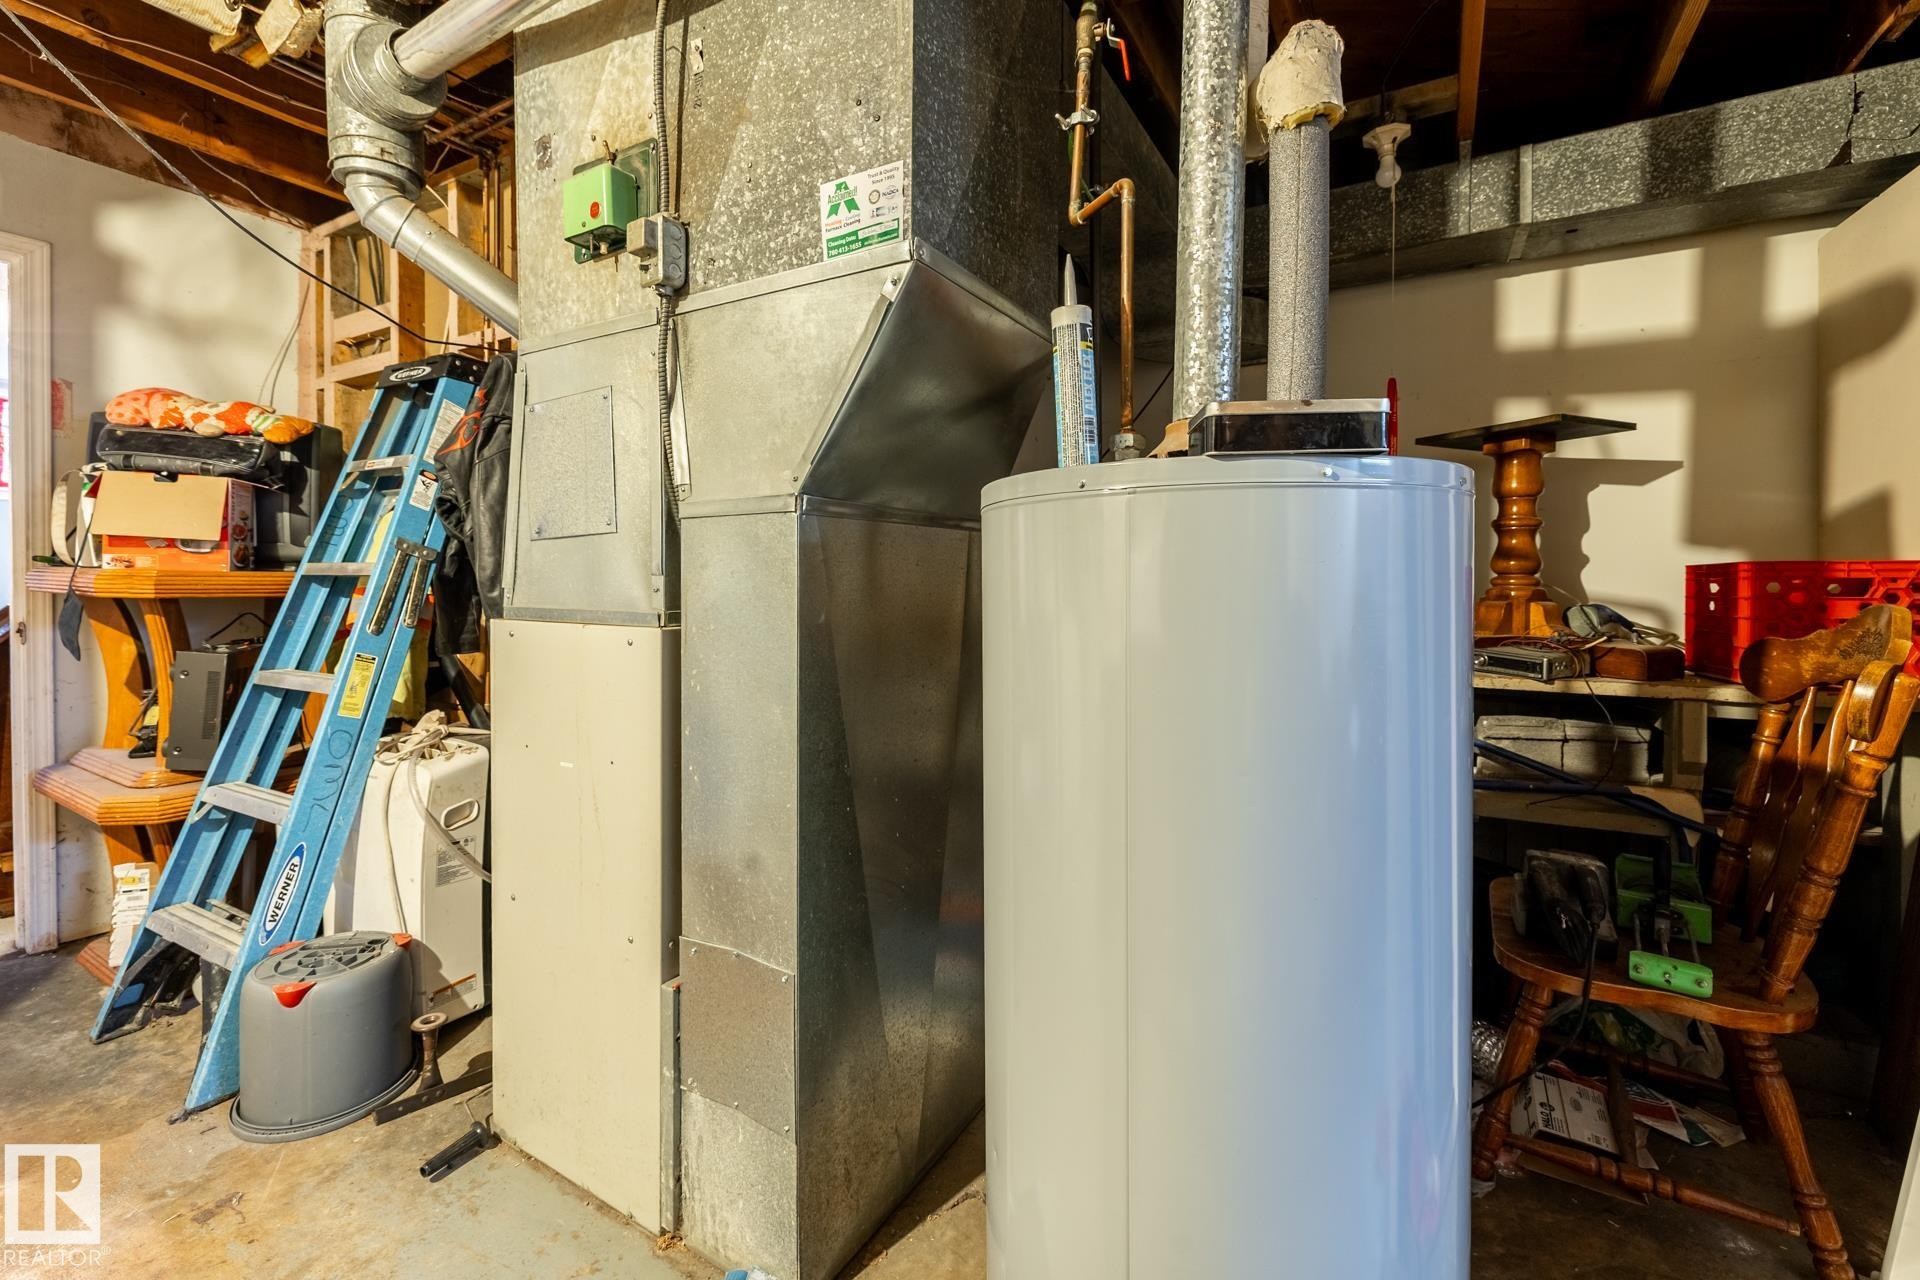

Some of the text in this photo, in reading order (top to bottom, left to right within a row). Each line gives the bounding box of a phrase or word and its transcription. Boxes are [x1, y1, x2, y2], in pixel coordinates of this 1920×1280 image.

[867, 171, 879, 179] Trust
[883, 166, 899, 174] Quality
[843, 218, 860, 228] Cleaning
[828, 239, 846, 248] Cleaning
[845, 235, 857, 243] Date:
[1084, 383, 1094, 411] ALEX
[268, 860, 299, 925] WERNER
